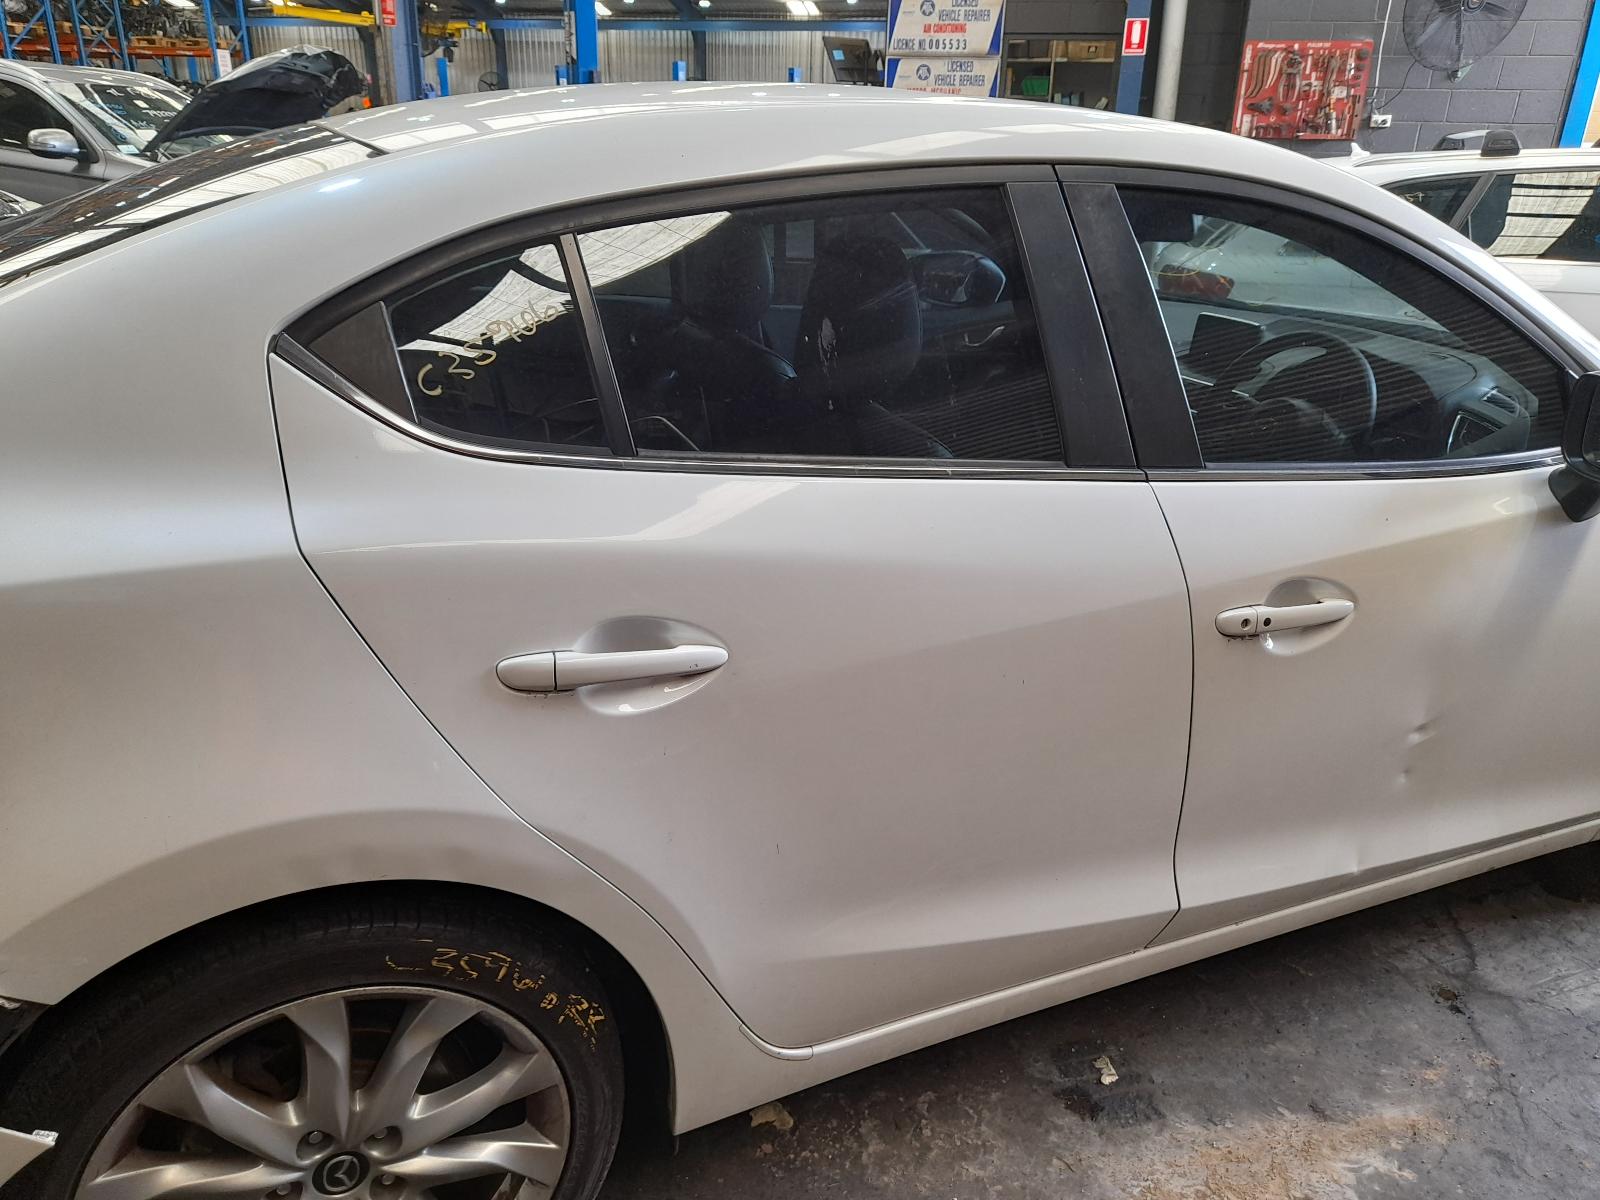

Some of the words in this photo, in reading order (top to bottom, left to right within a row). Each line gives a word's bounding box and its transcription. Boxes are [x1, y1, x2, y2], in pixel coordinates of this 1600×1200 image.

[938, 9, 961, 22] VEHICLE
[963, 9, 991, 22] REPAIRER
[923, 23, 932, 34] AIR
[933, 23, 967, 34] CONDITIONING
[893, 38, 915, 51] LICENCE
[928, 39, 967, 50] 005533
[947, 60, 974, 73] LICENSED
[934, 74, 956, 87] VEHICLE
[959, 74, 985, 87] REPAIRER
